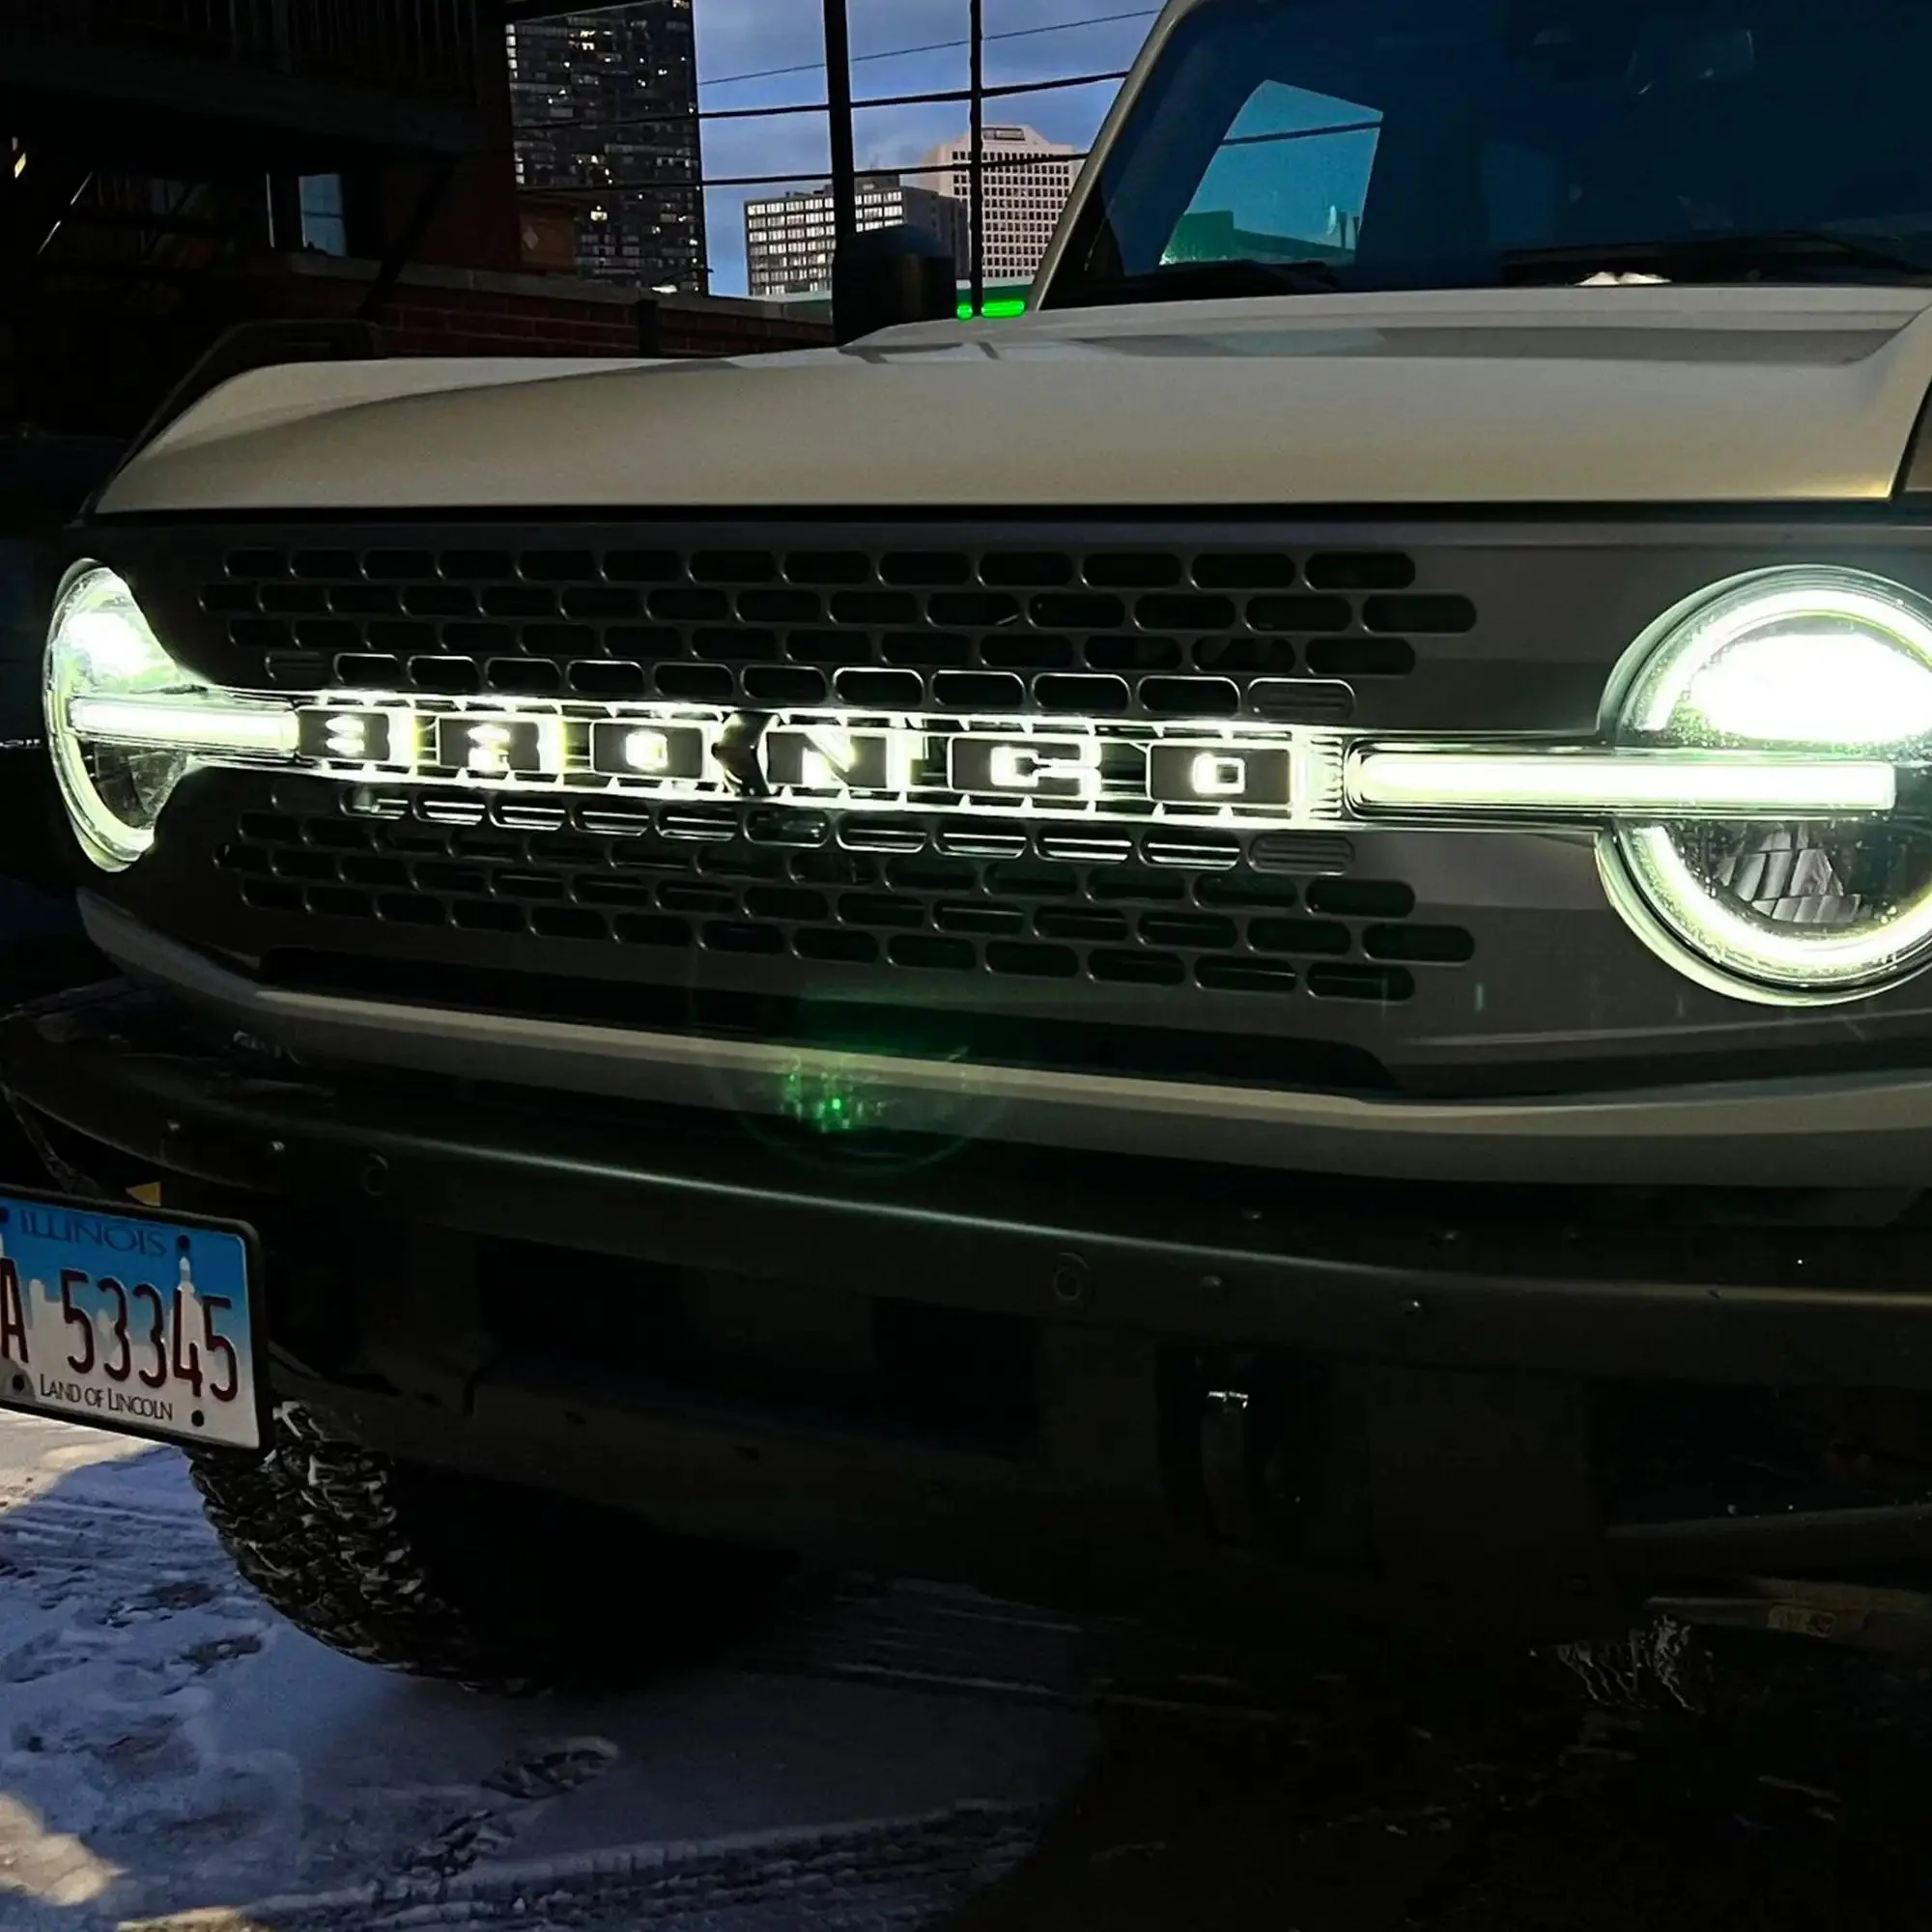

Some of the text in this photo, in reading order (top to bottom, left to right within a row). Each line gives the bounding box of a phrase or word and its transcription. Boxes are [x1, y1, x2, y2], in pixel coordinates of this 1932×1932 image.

[294, 704, 1293, 808] BRONCO
[21, 1209, 168, 1256] ILLINOIS
[60, 1269, 238, 1401] 53345
[40, 1375, 173, 1420] LAND OF LINCOLN
